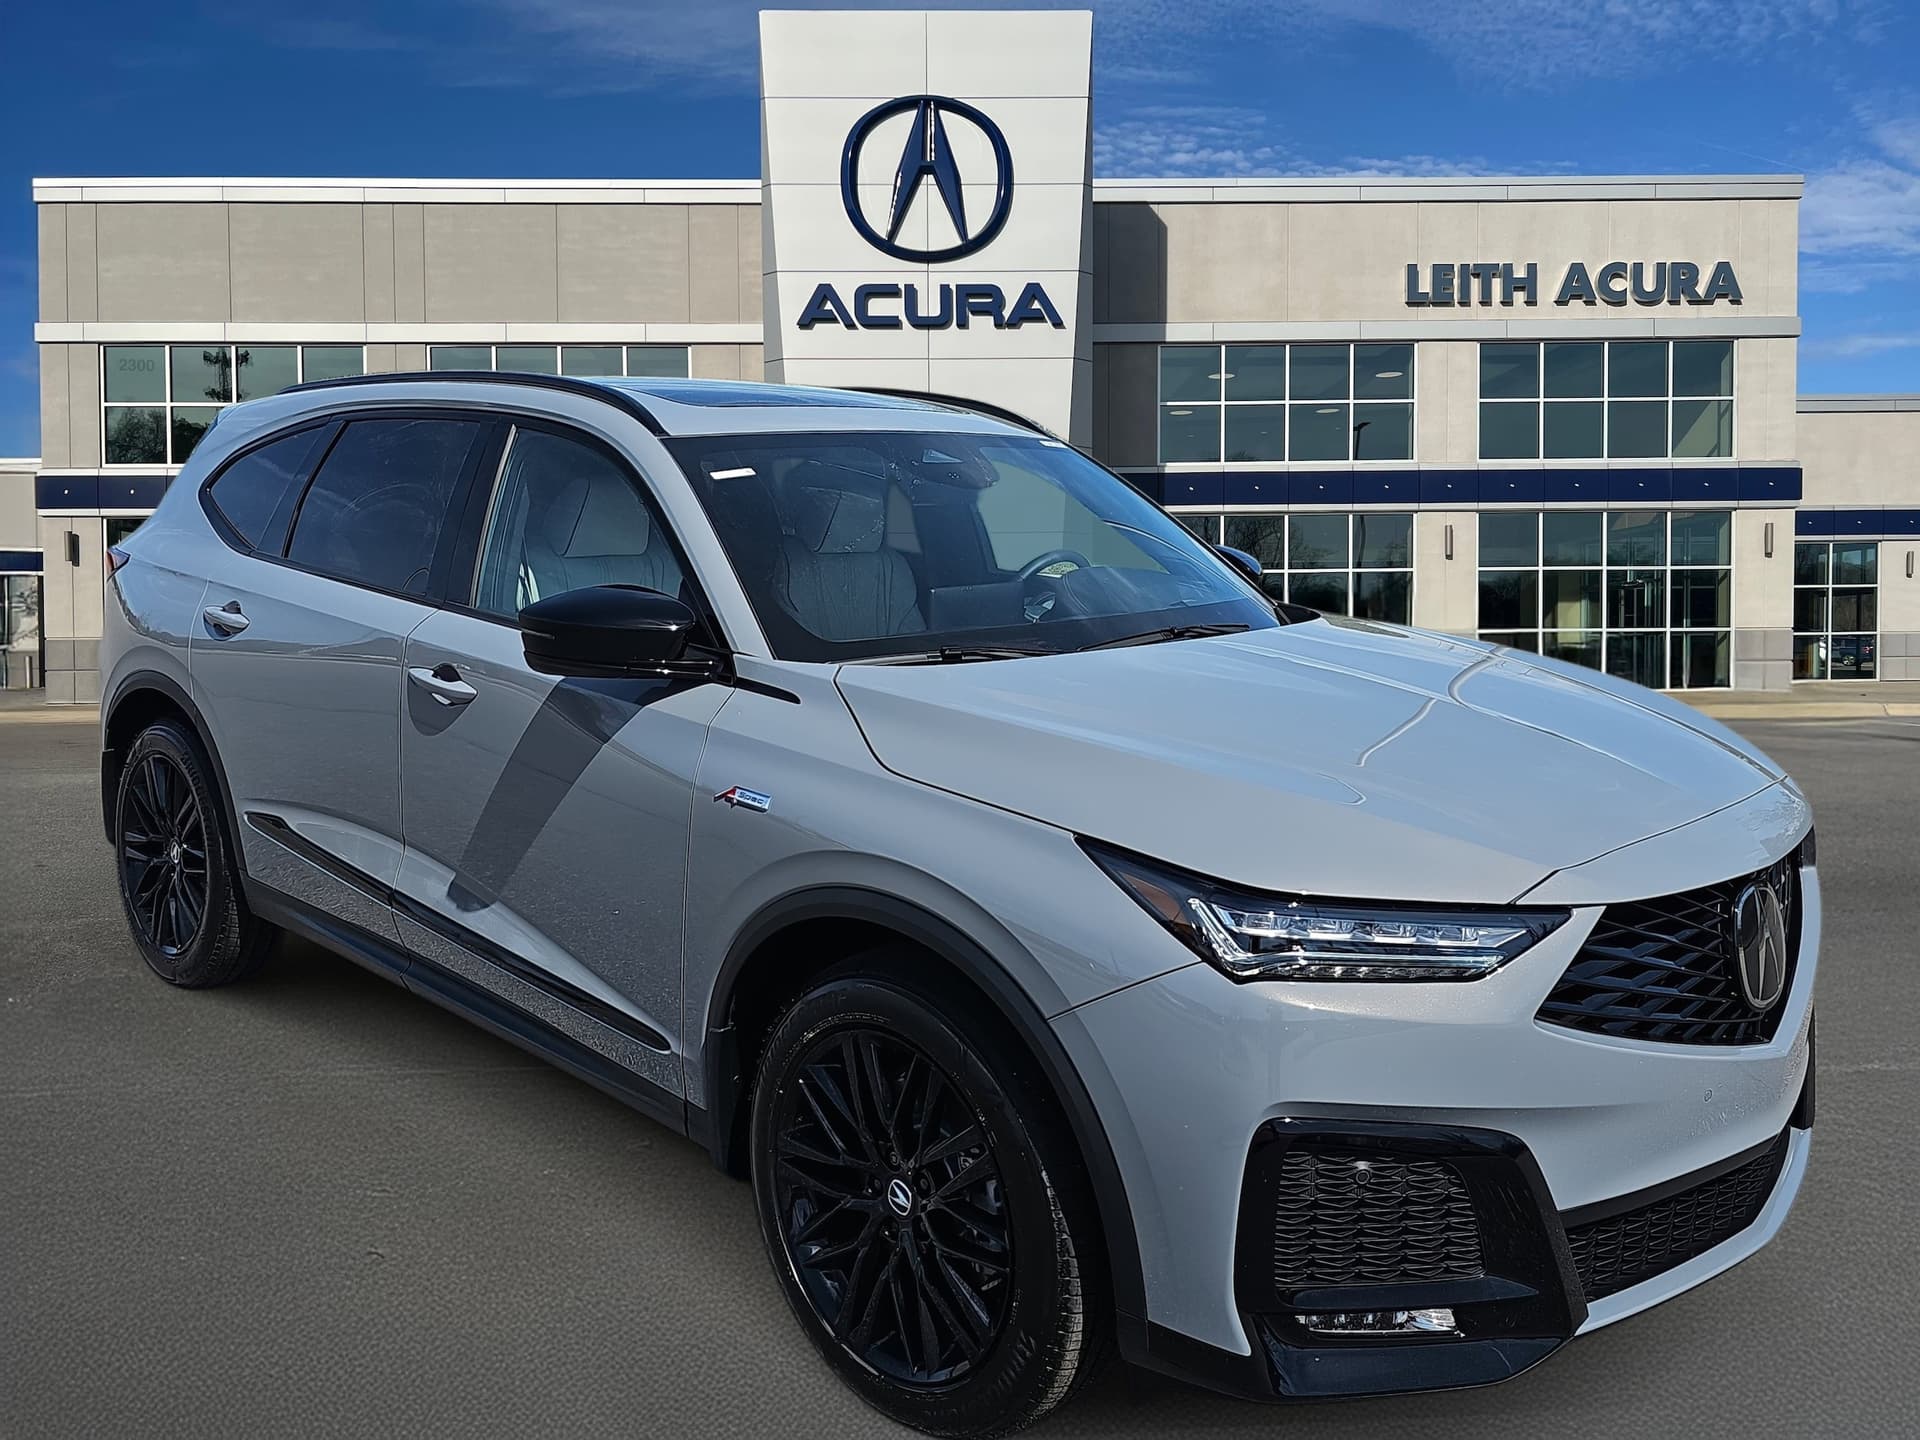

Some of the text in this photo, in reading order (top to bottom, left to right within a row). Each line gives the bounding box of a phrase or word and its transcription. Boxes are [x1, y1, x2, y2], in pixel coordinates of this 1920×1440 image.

[797, 283, 1066, 329] ACURA
[1405, 261, 1743, 307] LEITH ACURA
[119, 358, 154, 371] 2300
